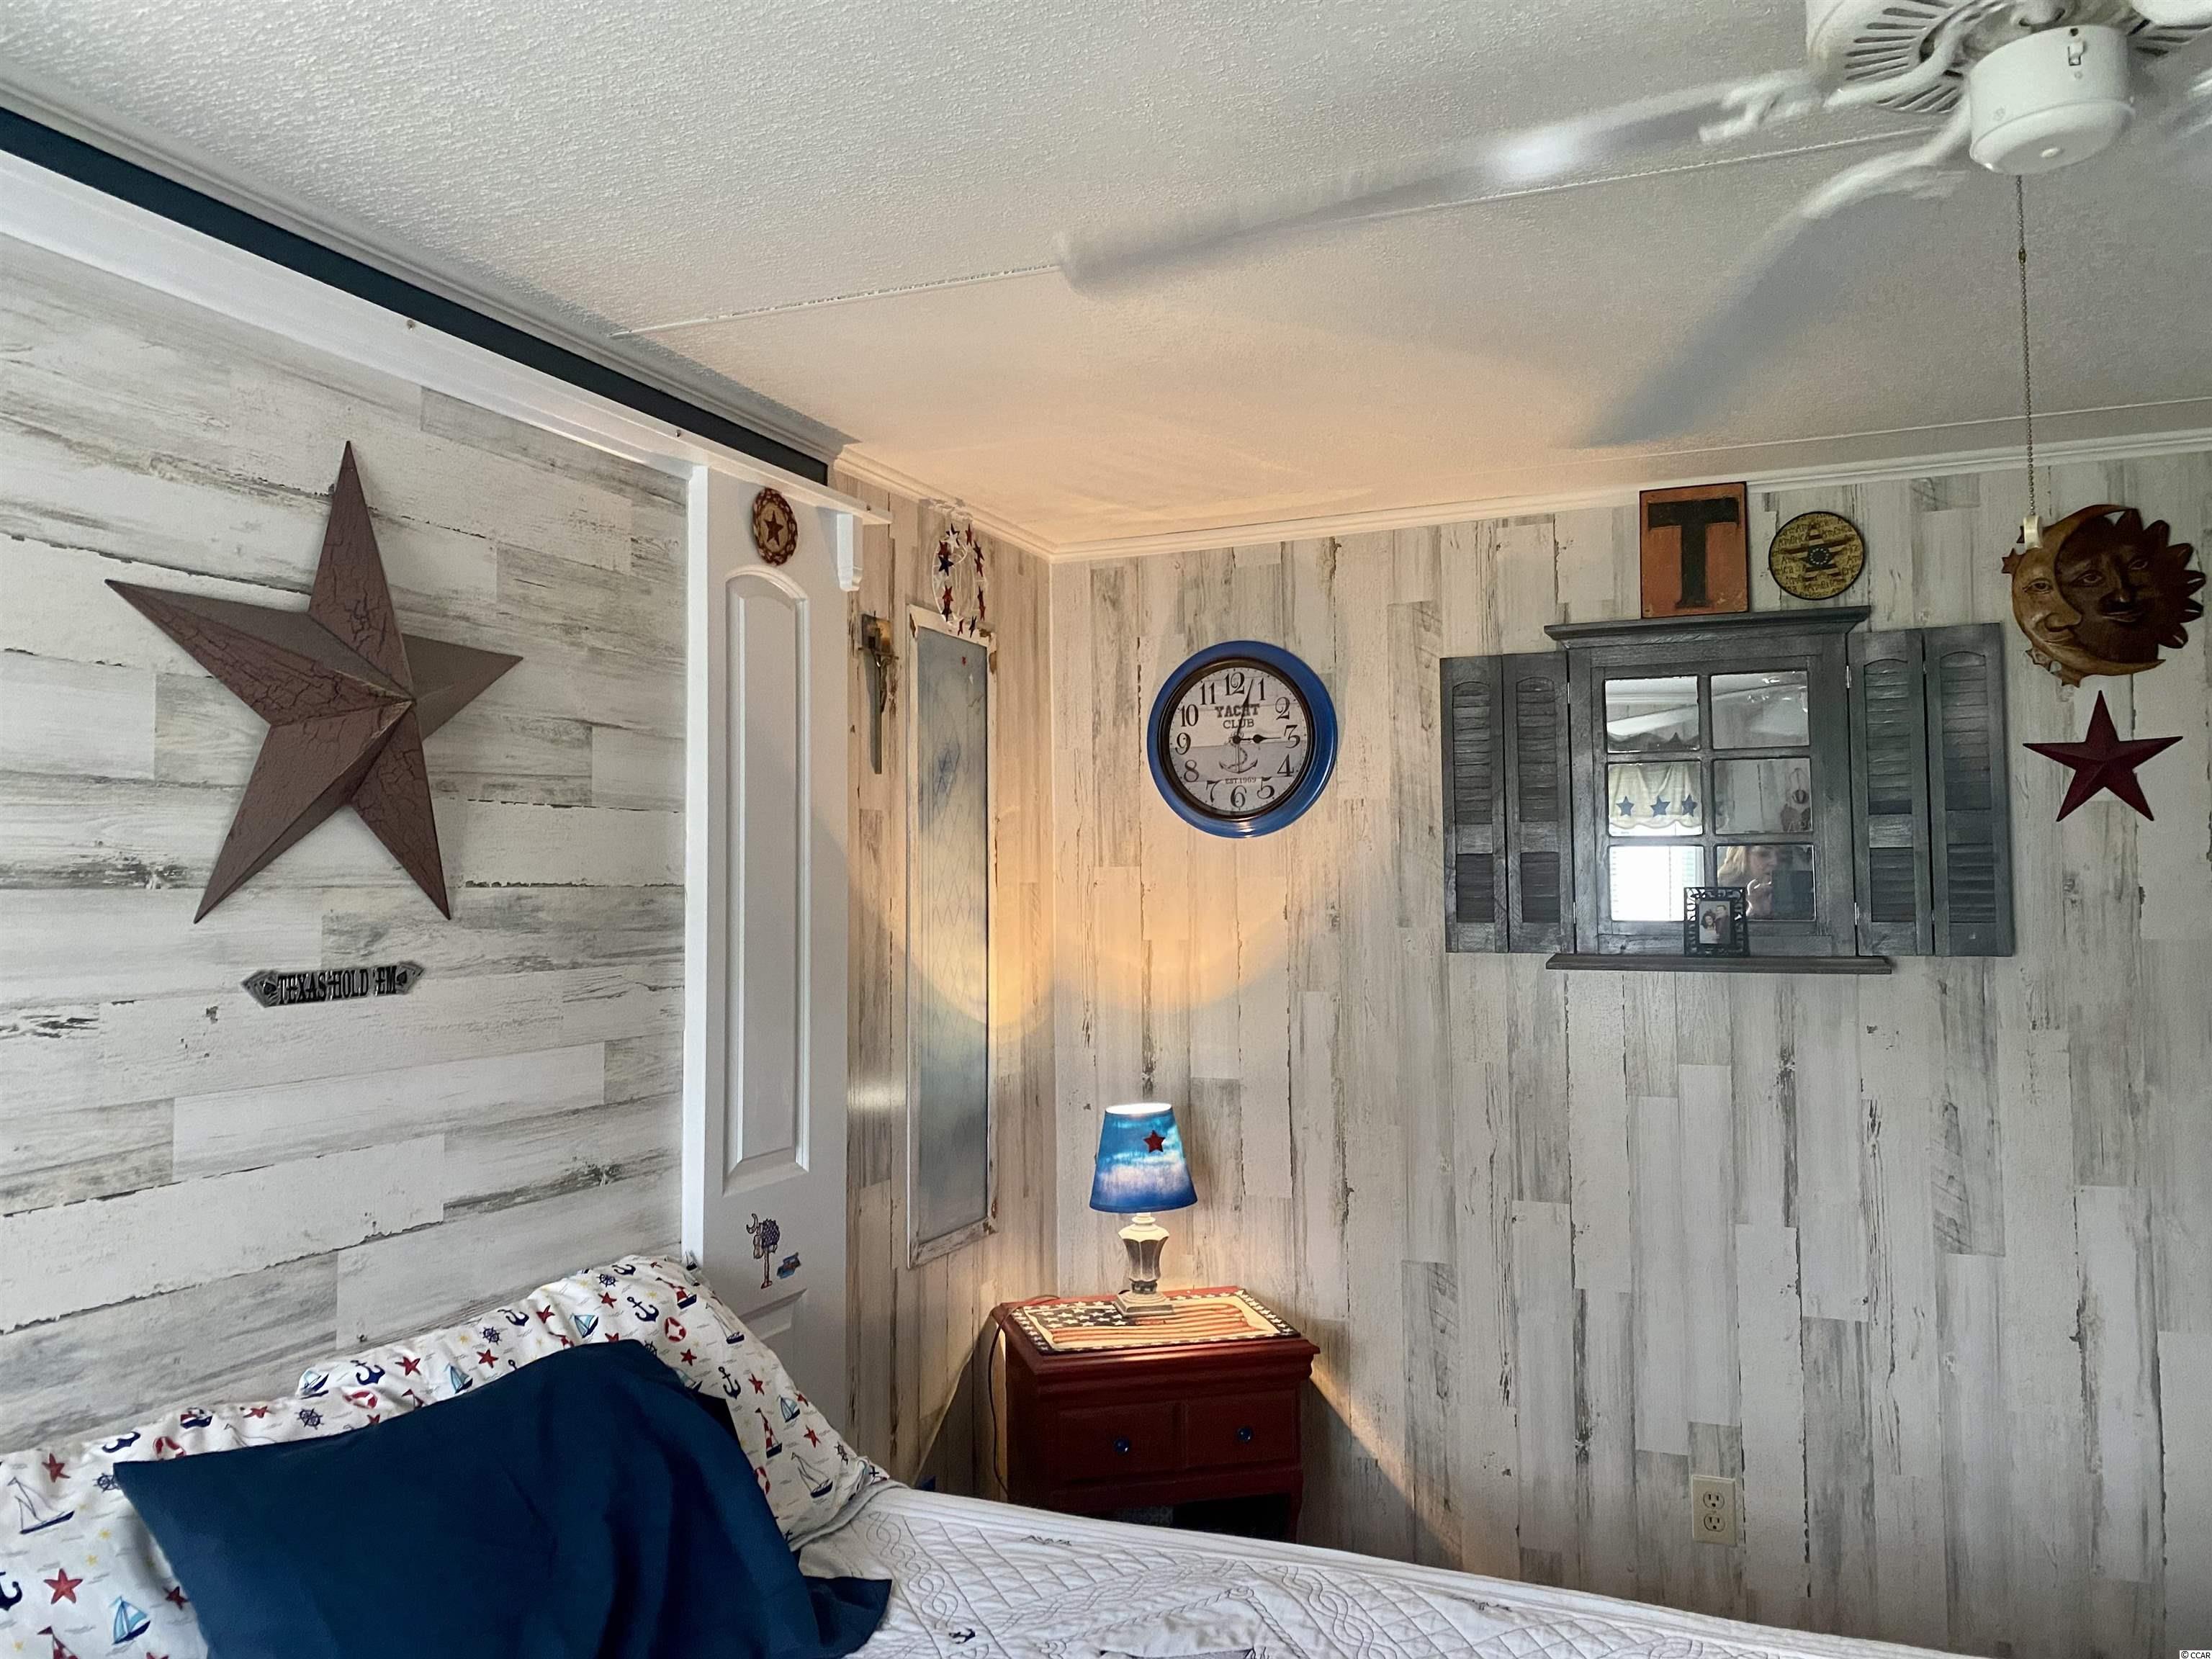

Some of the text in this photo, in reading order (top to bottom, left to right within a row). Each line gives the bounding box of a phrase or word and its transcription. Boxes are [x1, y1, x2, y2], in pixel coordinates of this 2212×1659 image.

[1647, 497, 1739, 608] T
[1199, 682, 1216, 705] 11
[1224, 672, 1245, 696] 12
[1258, 678, 1266, 701] 1
[1180, 703, 1199, 727] 10
[1215, 703, 1260, 718] YACHT
[1274, 697, 1290, 720] 2
[1223, 719, 1254, 729] CLUB
[1174, 732, 1192, 755] 9
[1283, 724, 1300, 748] 3
[1184, 760, 1200, 782] 8
[1277, 754, 1295, 777] 4
[1205, 780, 1222, 802] 7
[1230, 786, 1247, 808] 6
[1256, 776, 1274, 799] 5
[278, 972, 326, 1004] TEXAS
[327, 968, 369, 999] HOLD
